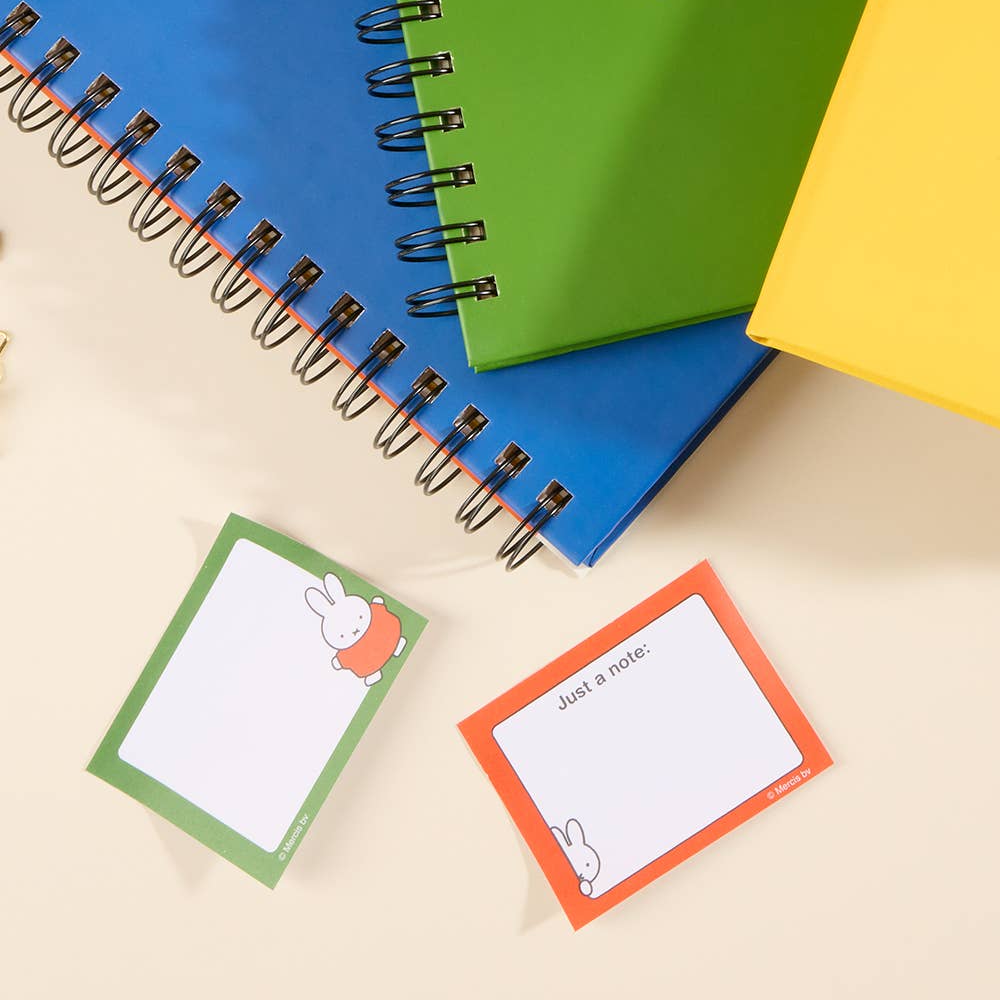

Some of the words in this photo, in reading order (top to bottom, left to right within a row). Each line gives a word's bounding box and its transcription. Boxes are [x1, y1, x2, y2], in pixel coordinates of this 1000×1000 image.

[557, 681, 592, 711] Just
[594, 672, 606, 686] a
[608, 643, 651, 676] note:
[774, 776, 801, 795] Mercis
